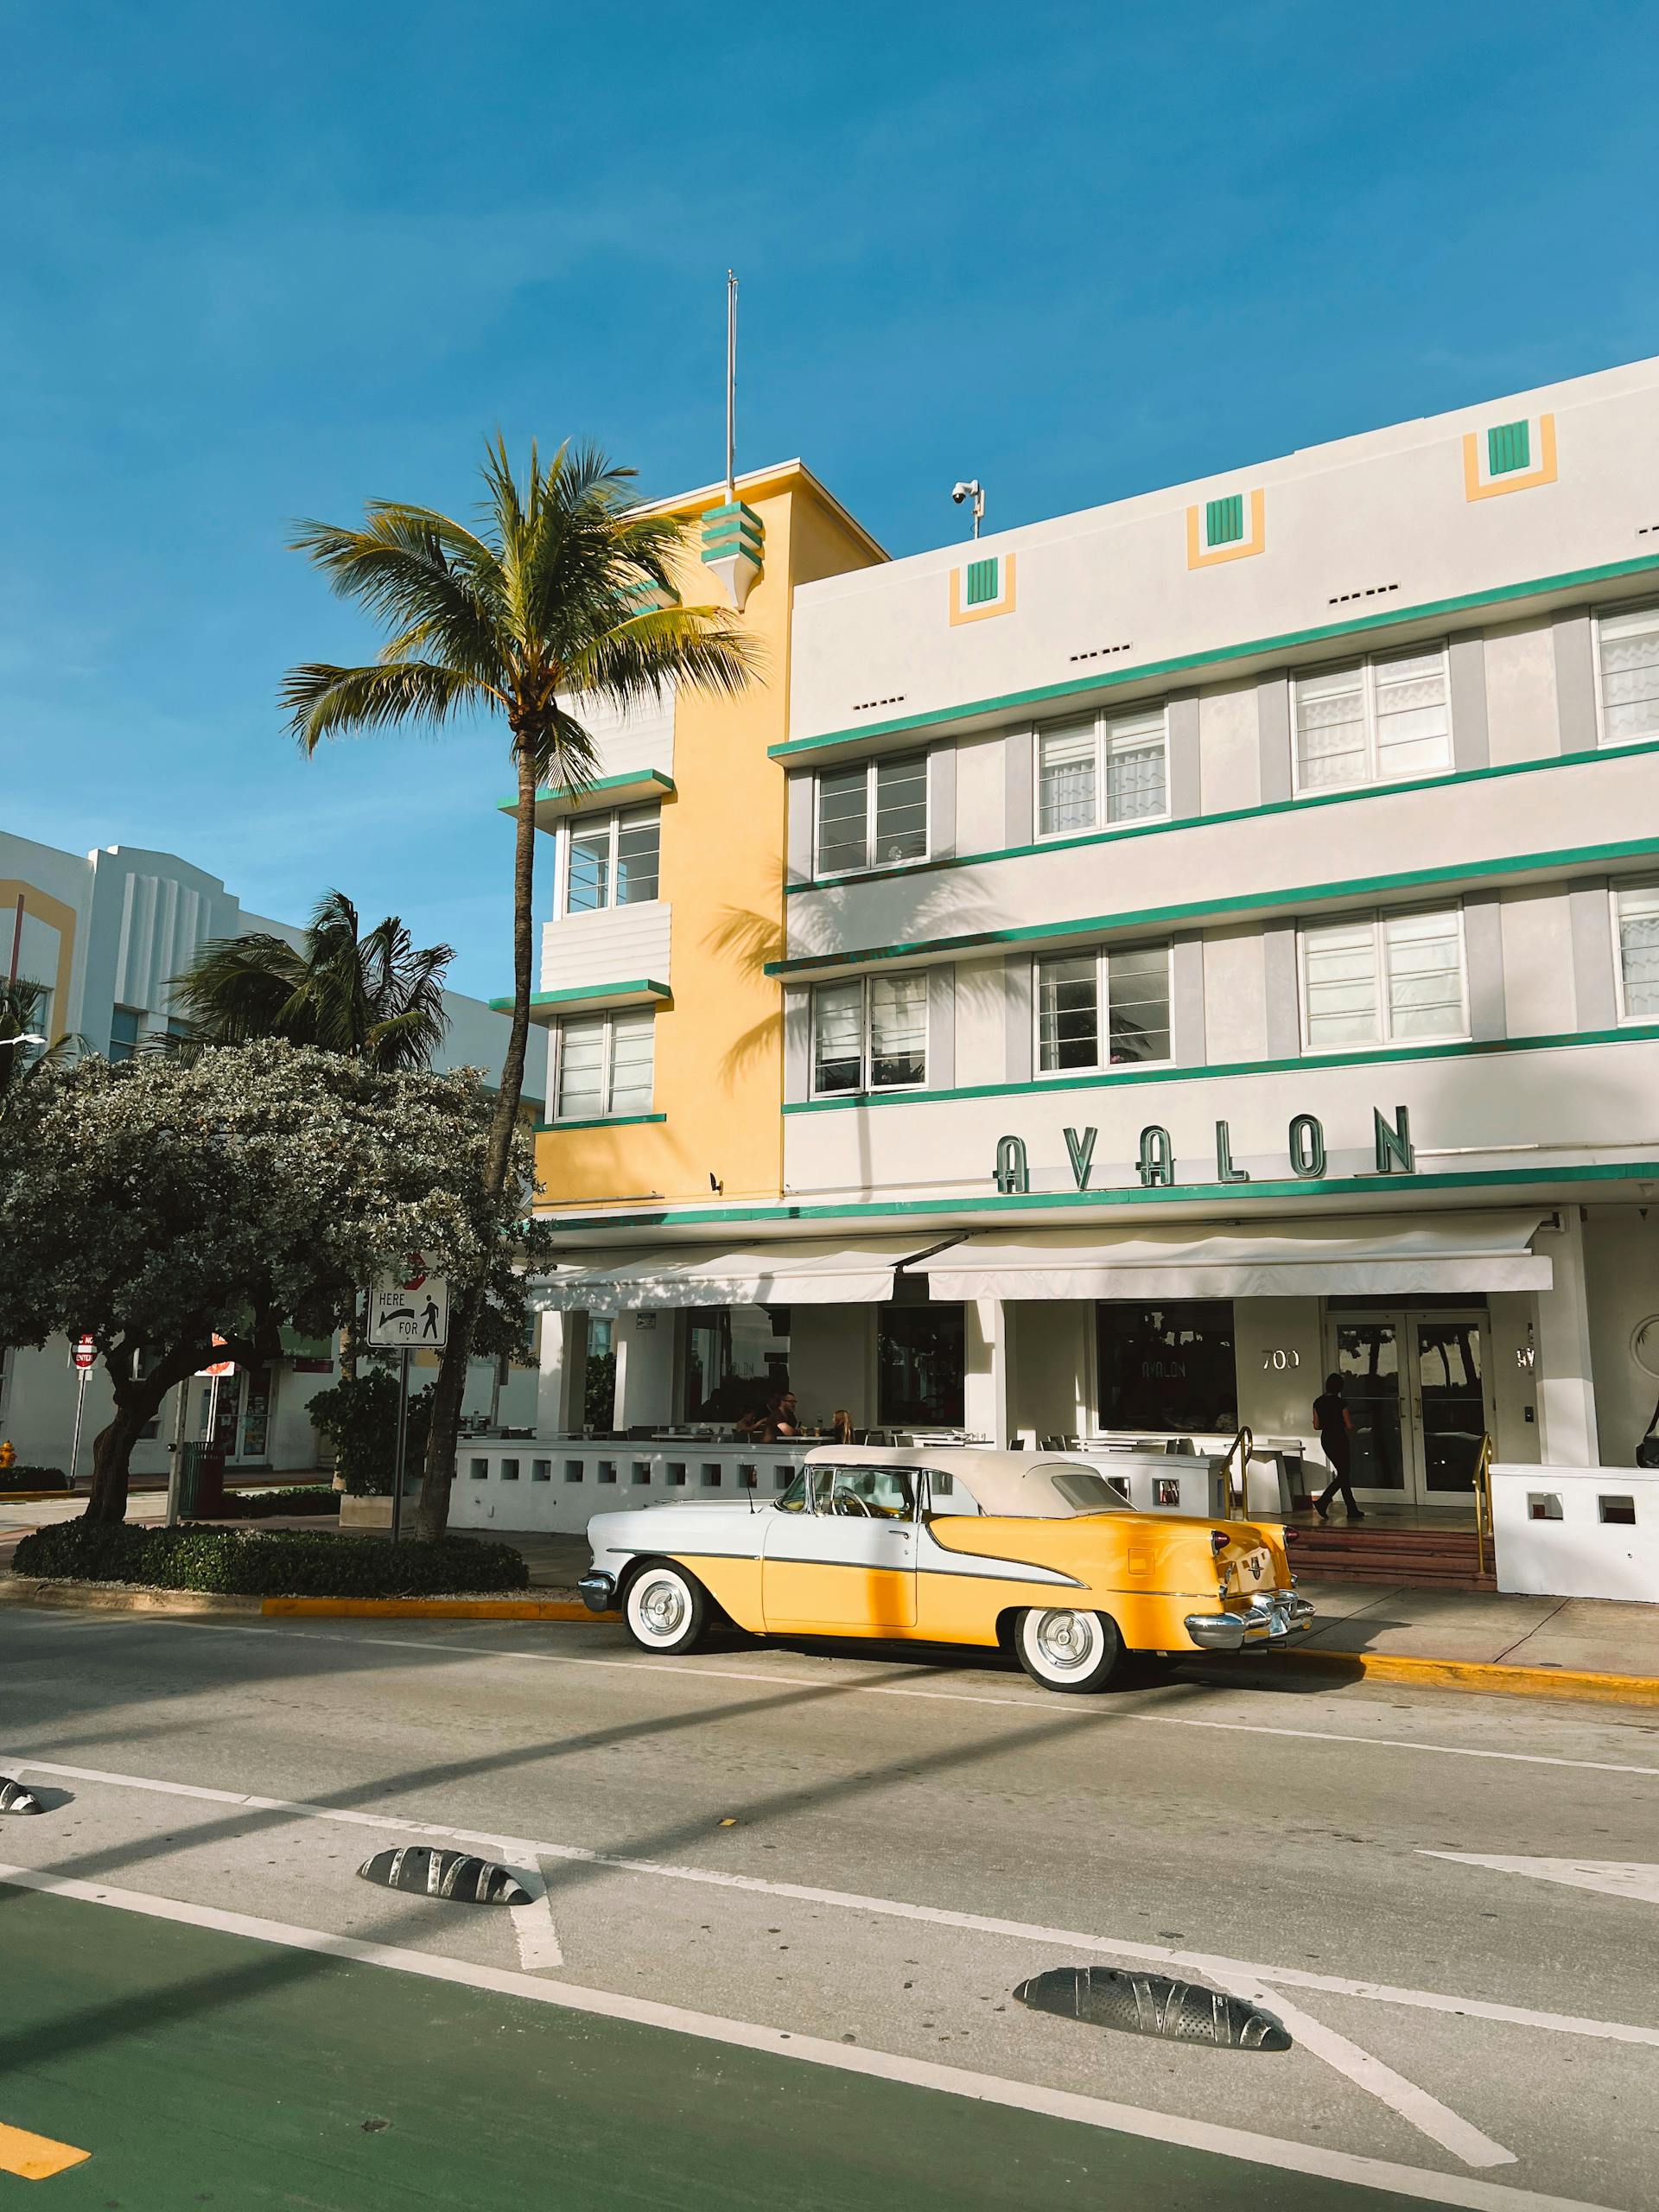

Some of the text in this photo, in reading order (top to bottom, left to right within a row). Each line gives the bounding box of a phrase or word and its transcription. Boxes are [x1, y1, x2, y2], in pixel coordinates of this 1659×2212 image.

[993, 1104, 1415, 1193] AVALON
[379, 1293, 405, 1306] HERE
[399, 1322, 418, 1335] FOR
[1262, 1349, 1300, 1370] 700
[1141, 1361, 1186, 1377] AVALON
